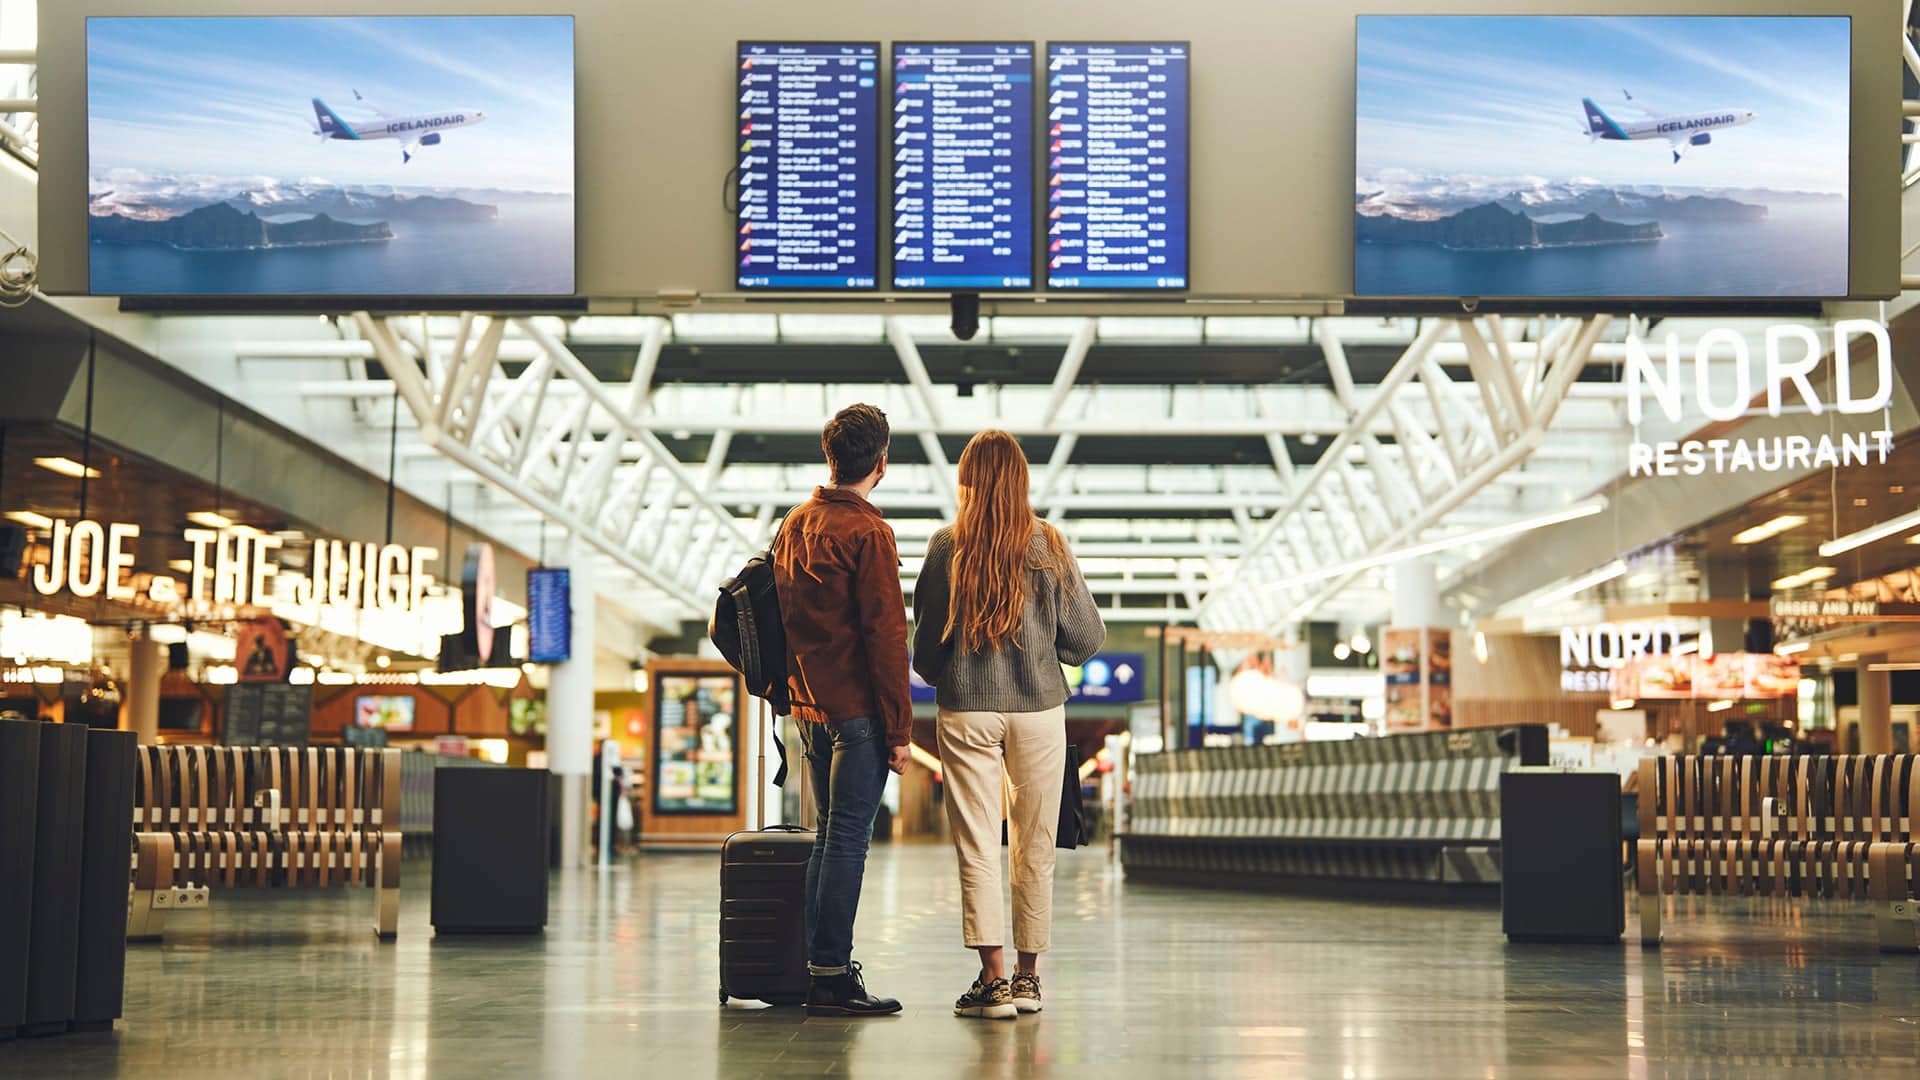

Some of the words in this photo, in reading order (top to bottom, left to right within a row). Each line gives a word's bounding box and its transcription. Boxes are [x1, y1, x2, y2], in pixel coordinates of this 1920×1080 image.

[387, 115, 465, 134] ICELANDAIR
[1657, 115, 1735, 134] ICELANDAIR
[1625, 319, 1892, 425] NORD
[1629, 431, 1892, 477] RESTAURANT
[34, 519, 140, 599] JOE
[184, 528, 283, 607] THE
